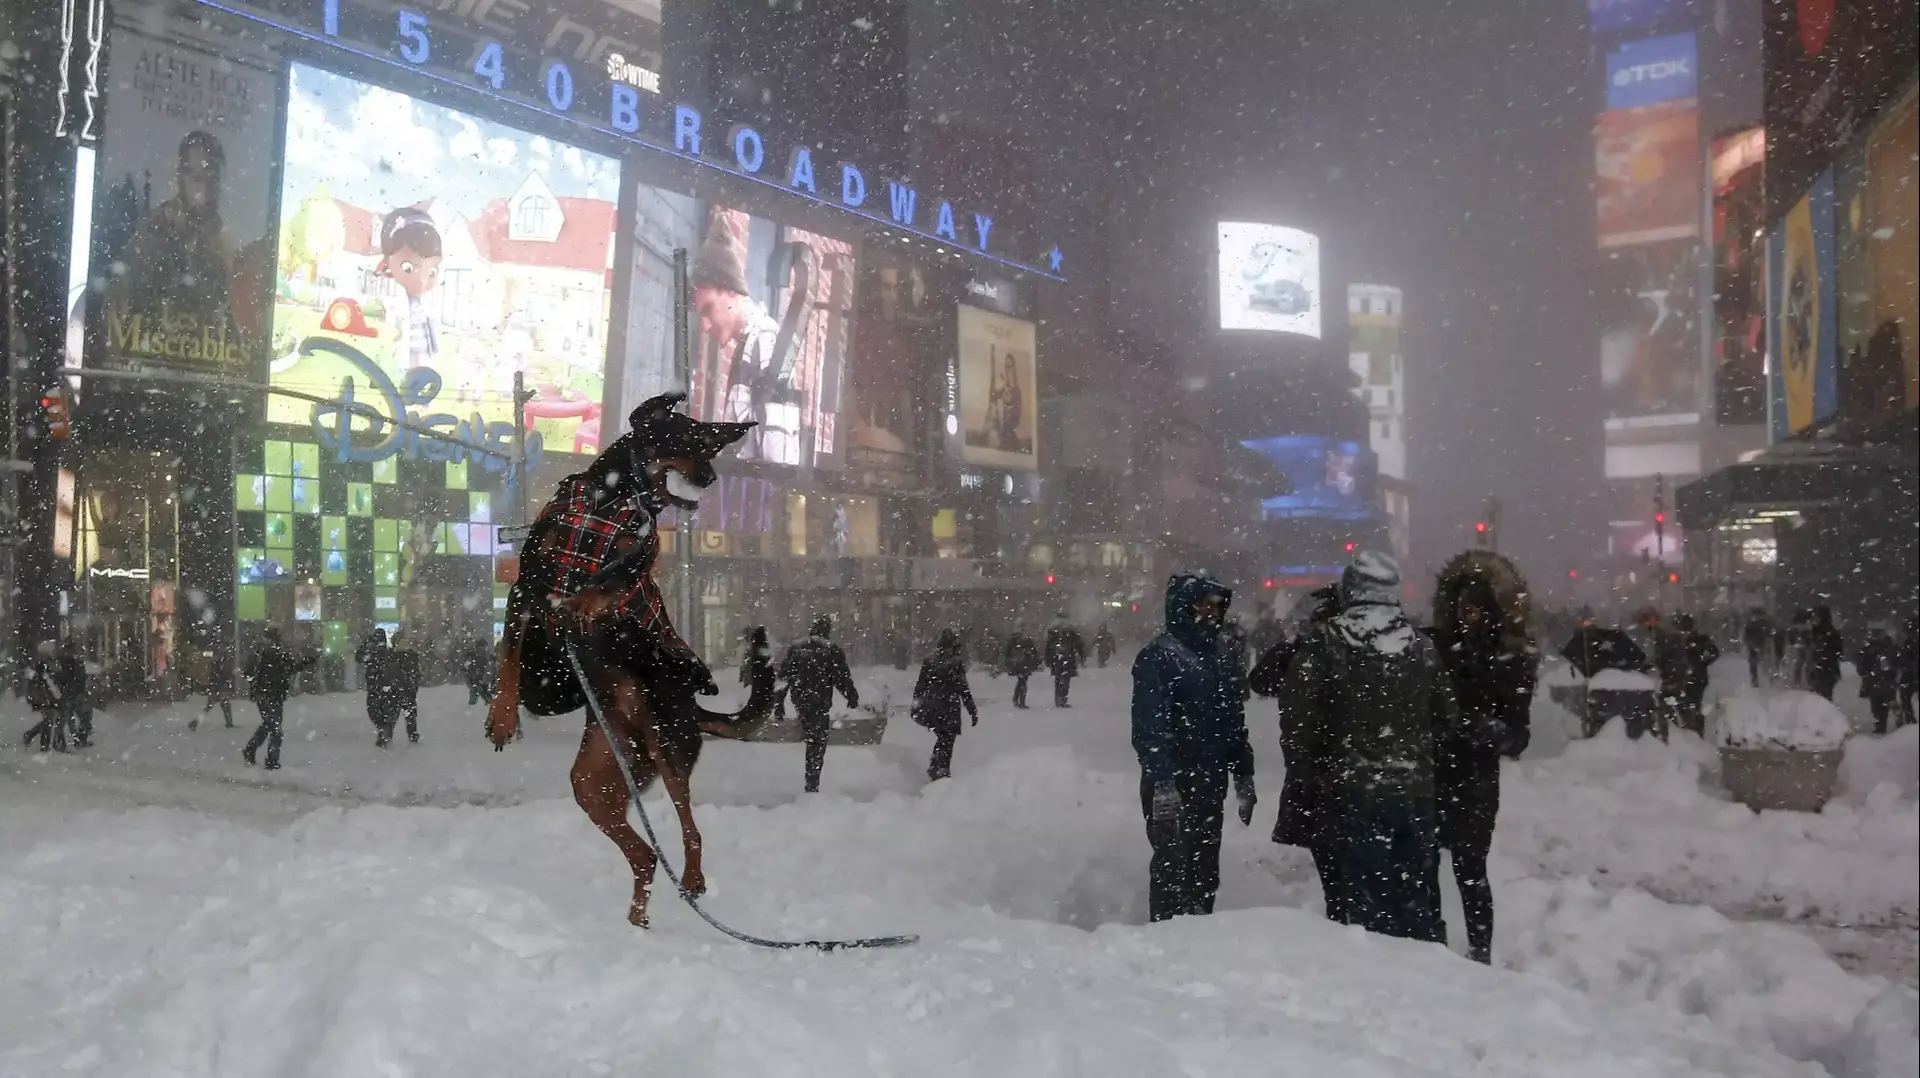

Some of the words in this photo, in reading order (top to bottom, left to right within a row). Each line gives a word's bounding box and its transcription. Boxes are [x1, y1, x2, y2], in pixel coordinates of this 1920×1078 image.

[322, 0, 574, 111] 1540
[610, 82, 992, 252] BROADWAY
[1629, 56, 1689, 82] TDK
